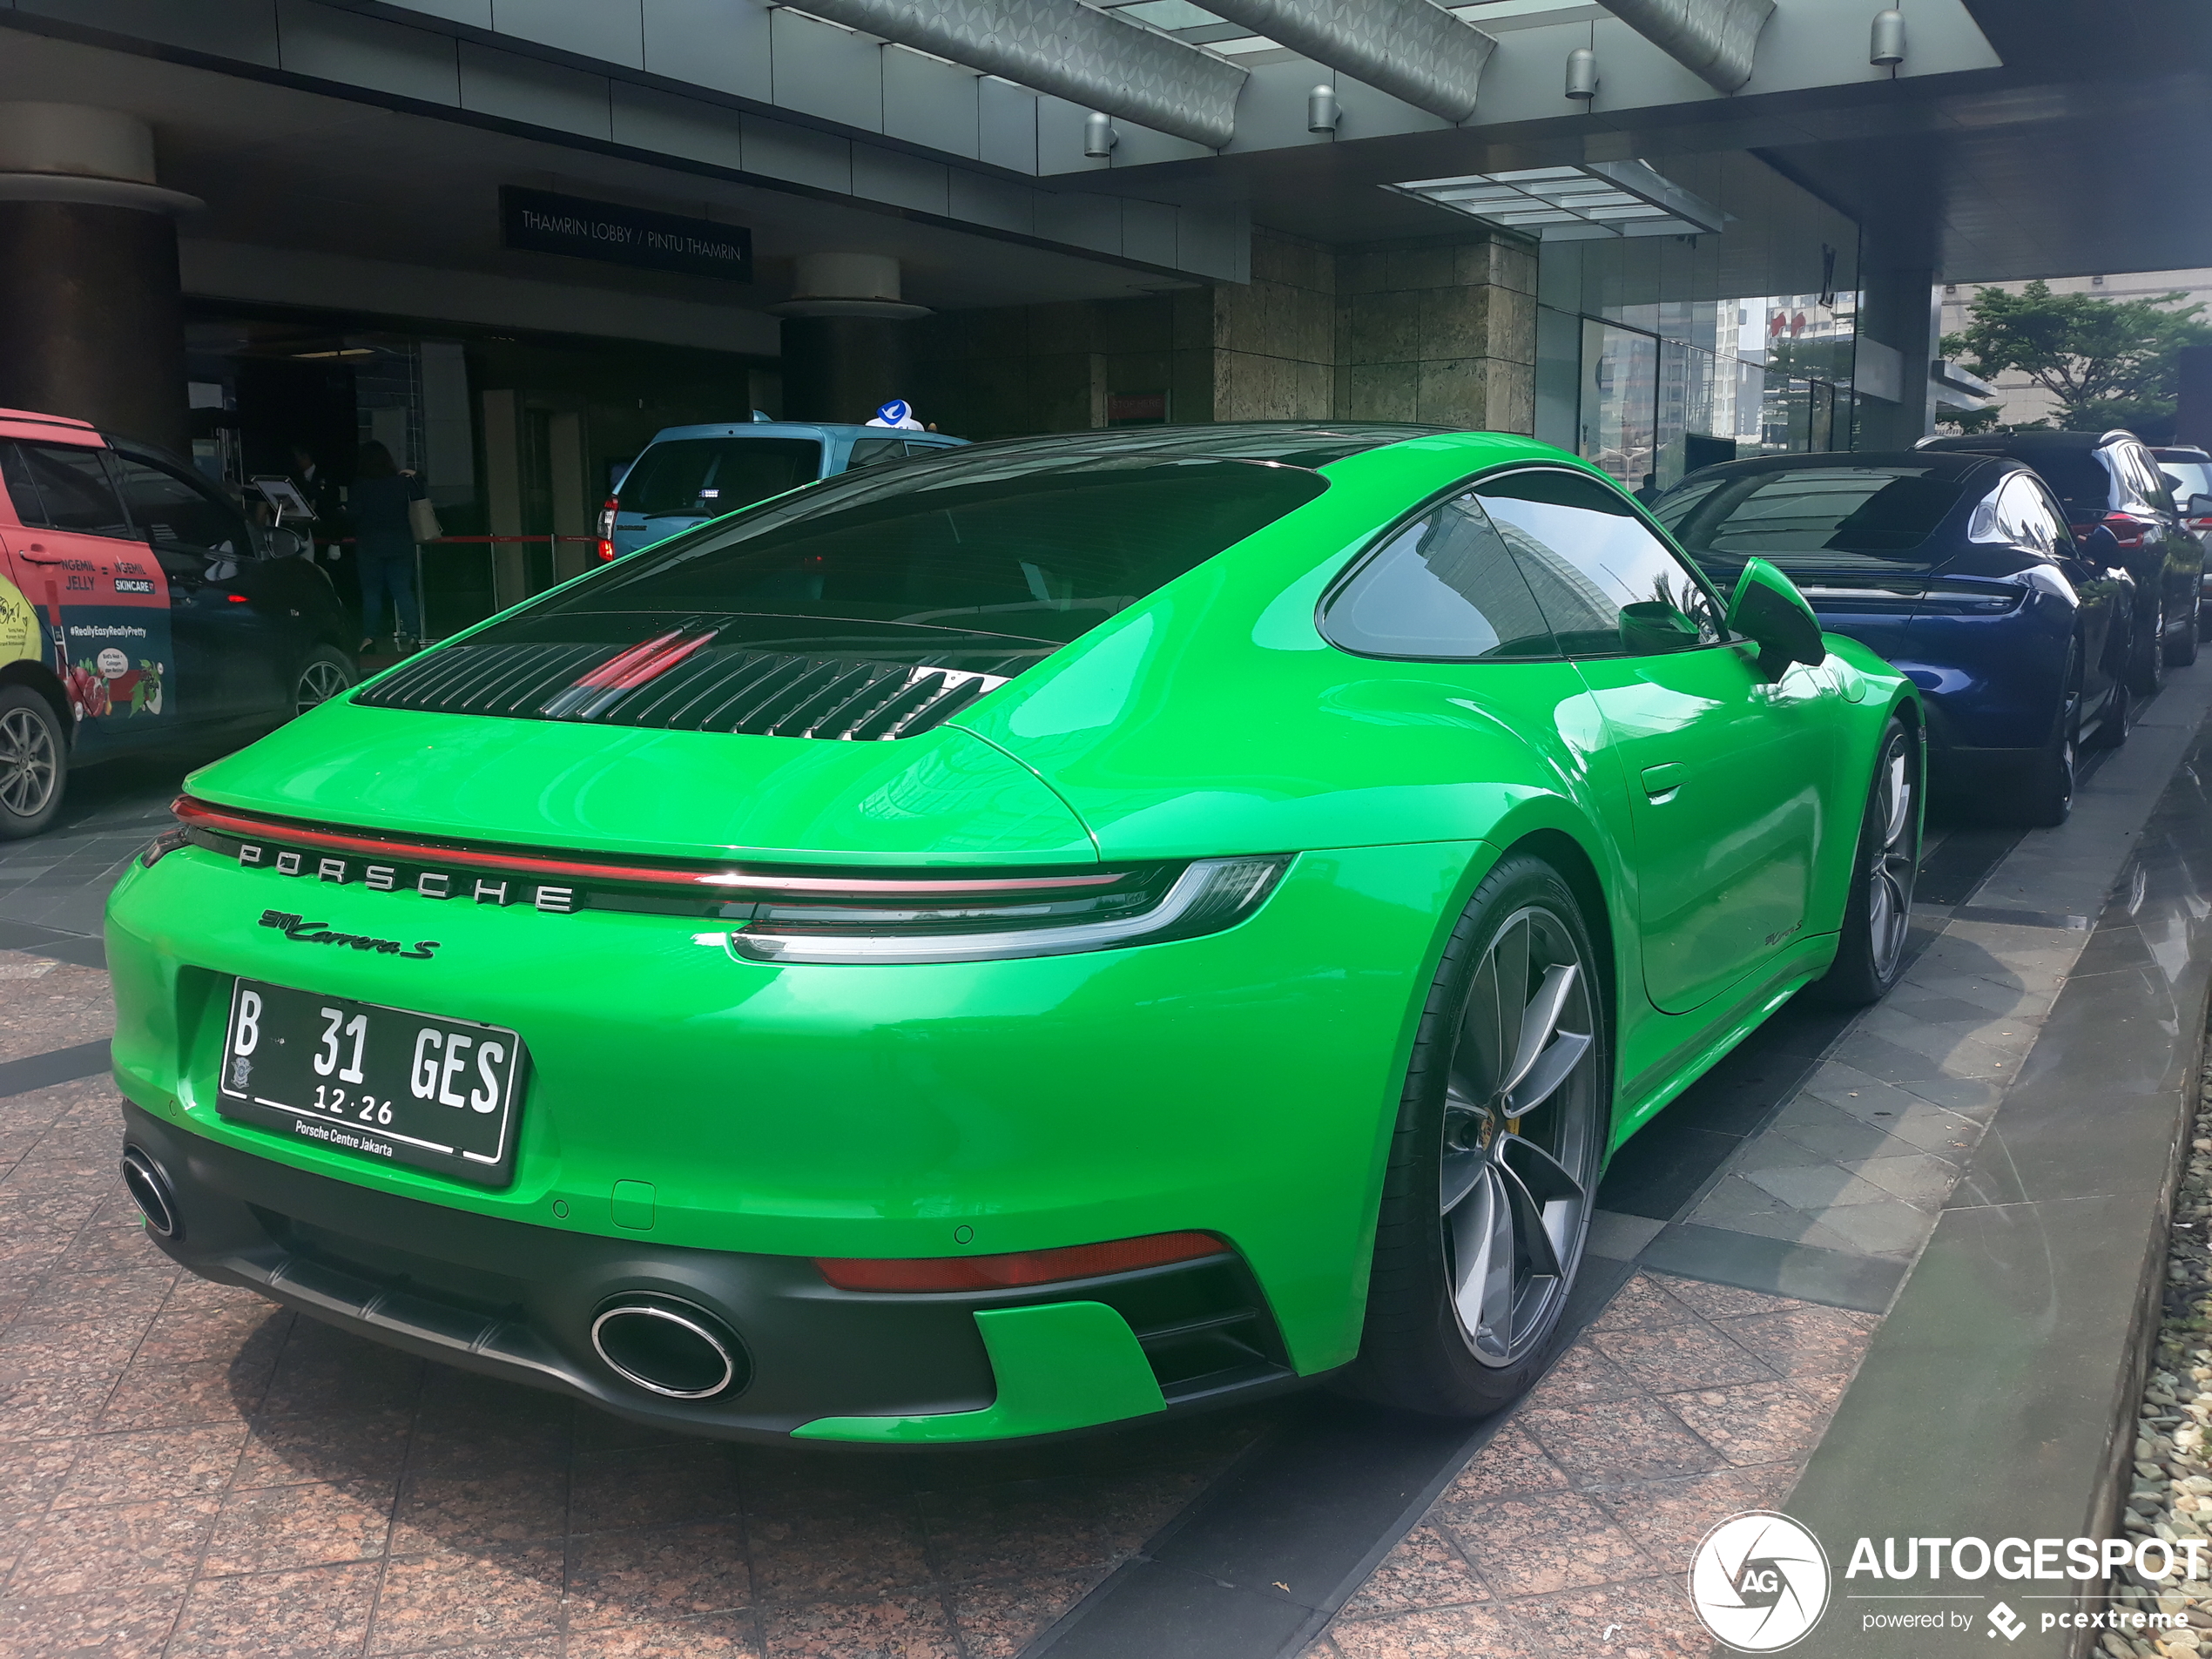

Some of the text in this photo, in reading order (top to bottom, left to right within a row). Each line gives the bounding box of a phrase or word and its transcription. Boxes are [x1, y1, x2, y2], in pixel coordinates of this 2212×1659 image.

[523, 211, 740, 260] THAMRIN LOBBY / PINTU THAMRIN
[1111, 398, 1161, 409] STOP HERE
[62, 559, 96, 571] NGEMIL
[113, 562, 146, 575] NGEMIL
[66, 576, 150, 592] JELLY SKINCARE
[70, 625, 146, 638] #ReallyEasyReallyPretty
[239, 844, 574, 913] PORSCHE
[258, 908, 441, 959] 911 Carrera S
[233, 989, 504, 1114] B 31 GES
[295, 1119, 393, 1157] Porsche Centre Jakarta
